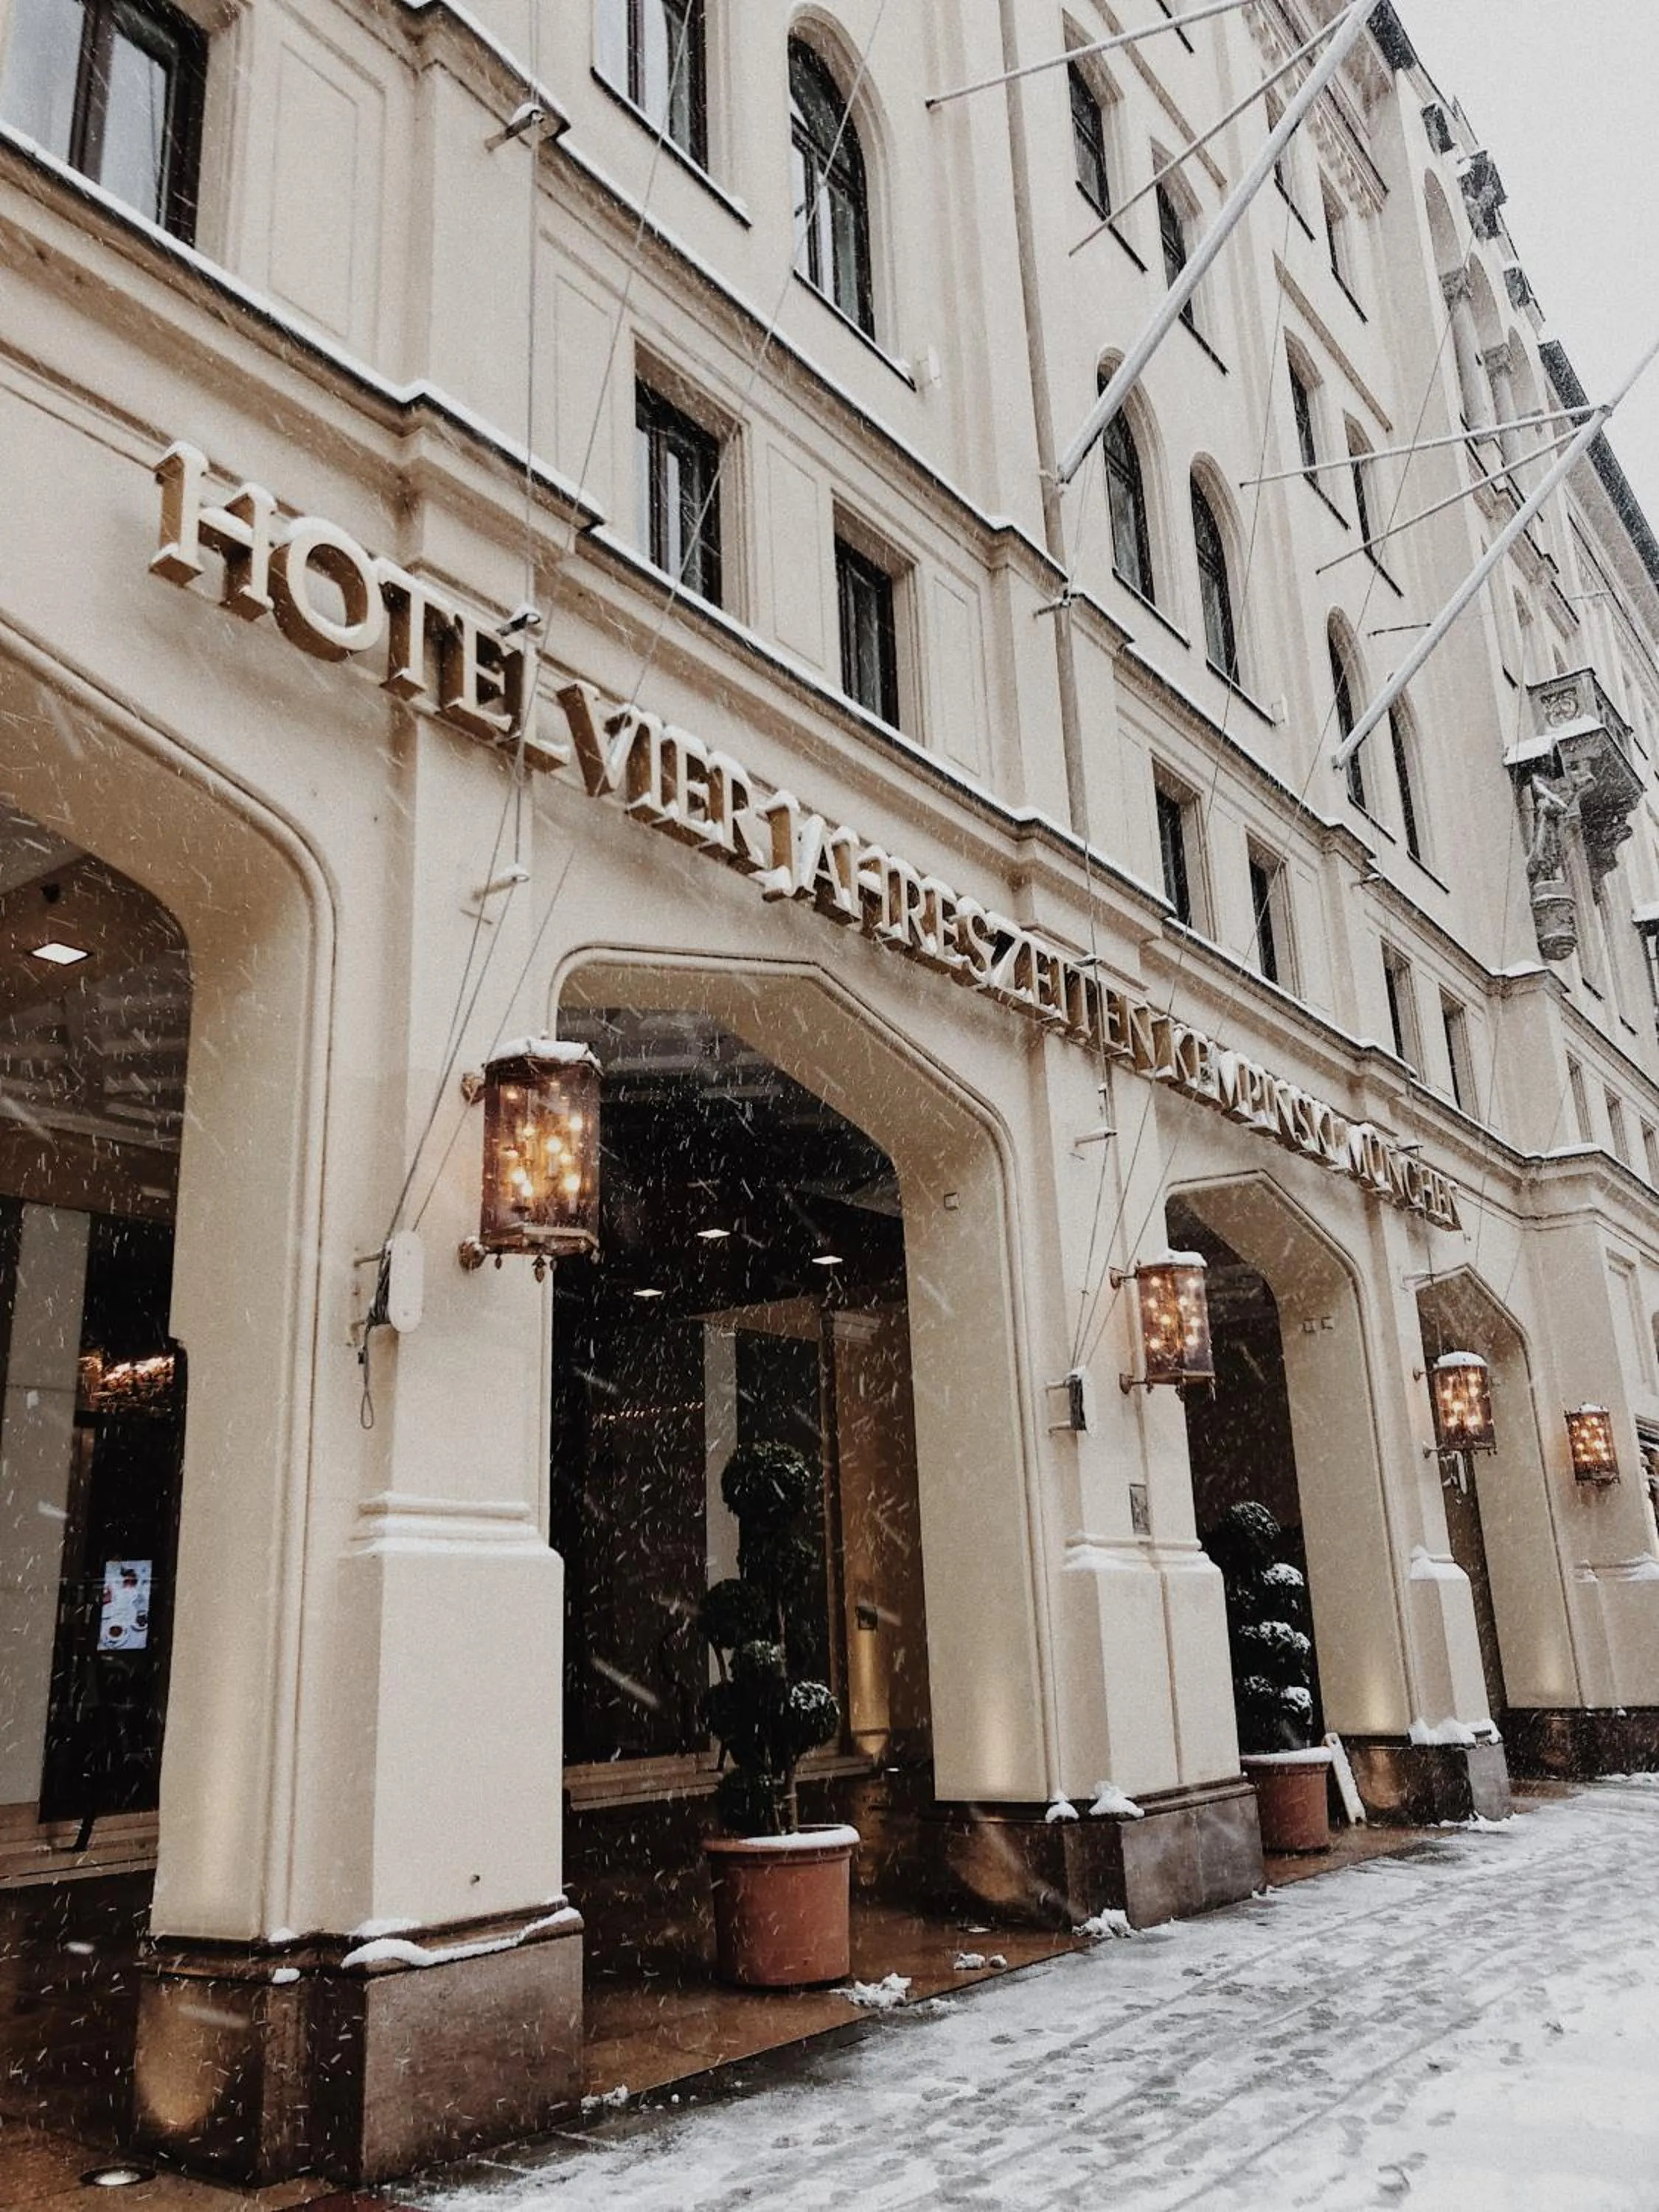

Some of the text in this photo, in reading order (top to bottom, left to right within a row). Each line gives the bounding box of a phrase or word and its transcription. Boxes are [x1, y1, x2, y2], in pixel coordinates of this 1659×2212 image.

[150, 442, 571, 773] HOTEL
[556, 678, 765, 874] VIER
[755, 789, 1158, 1073] JAHRESZEITEN
[1152, 1015, 1340, 1169] KEMPINSKI
